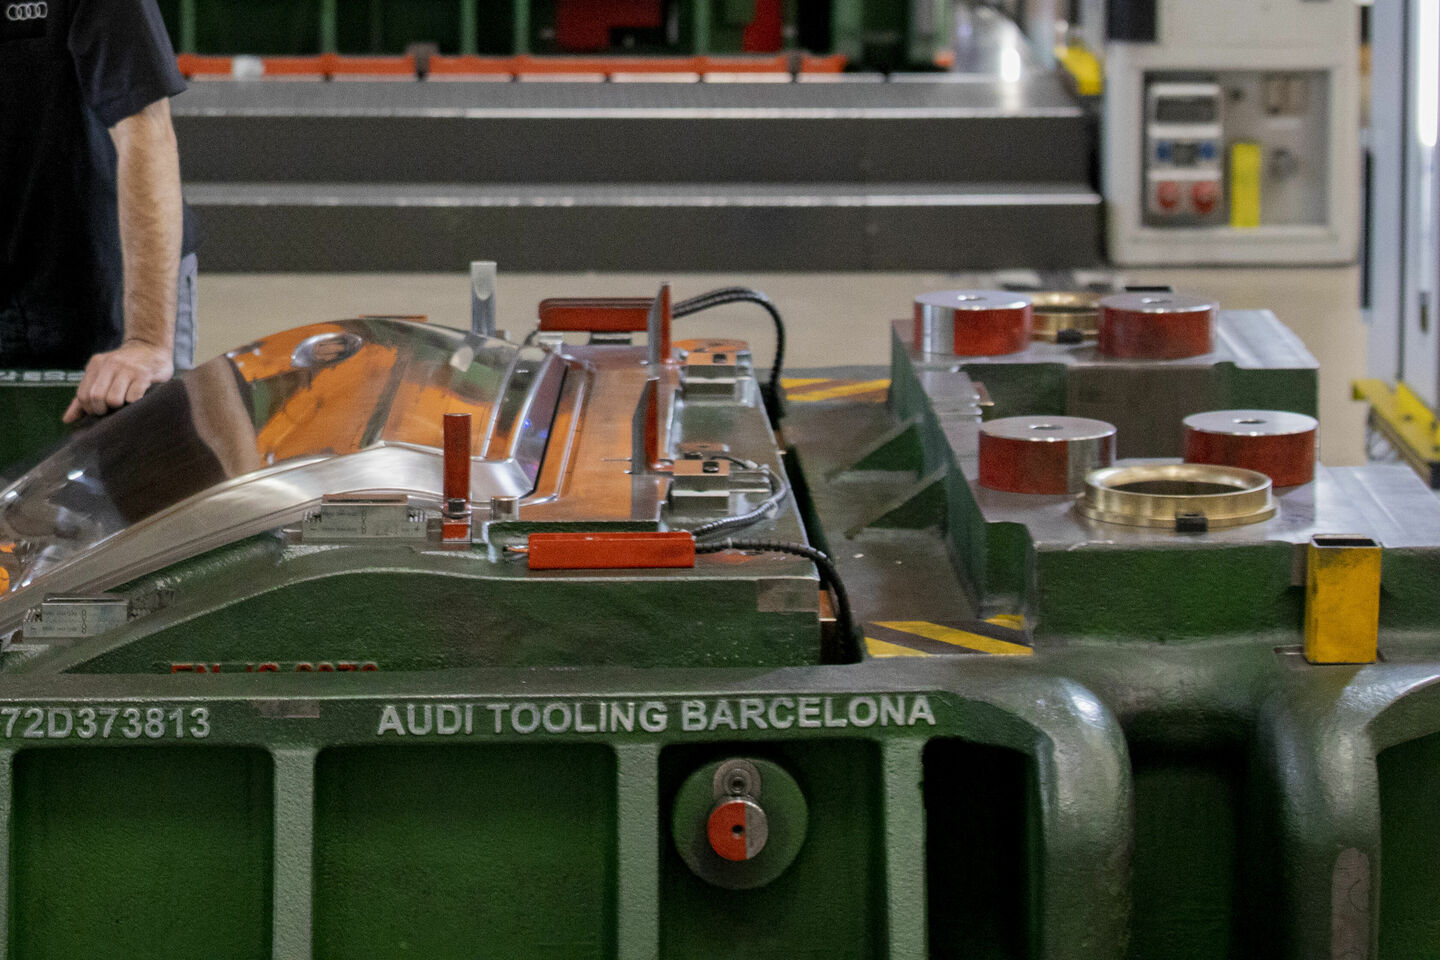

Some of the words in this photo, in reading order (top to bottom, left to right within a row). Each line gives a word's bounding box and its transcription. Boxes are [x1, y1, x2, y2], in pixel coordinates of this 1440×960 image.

[377, 704, 473, 737] AUDI
[487, 700, 668, 734] TOOLING
[681, 695, 937, 732] BARCELONA
